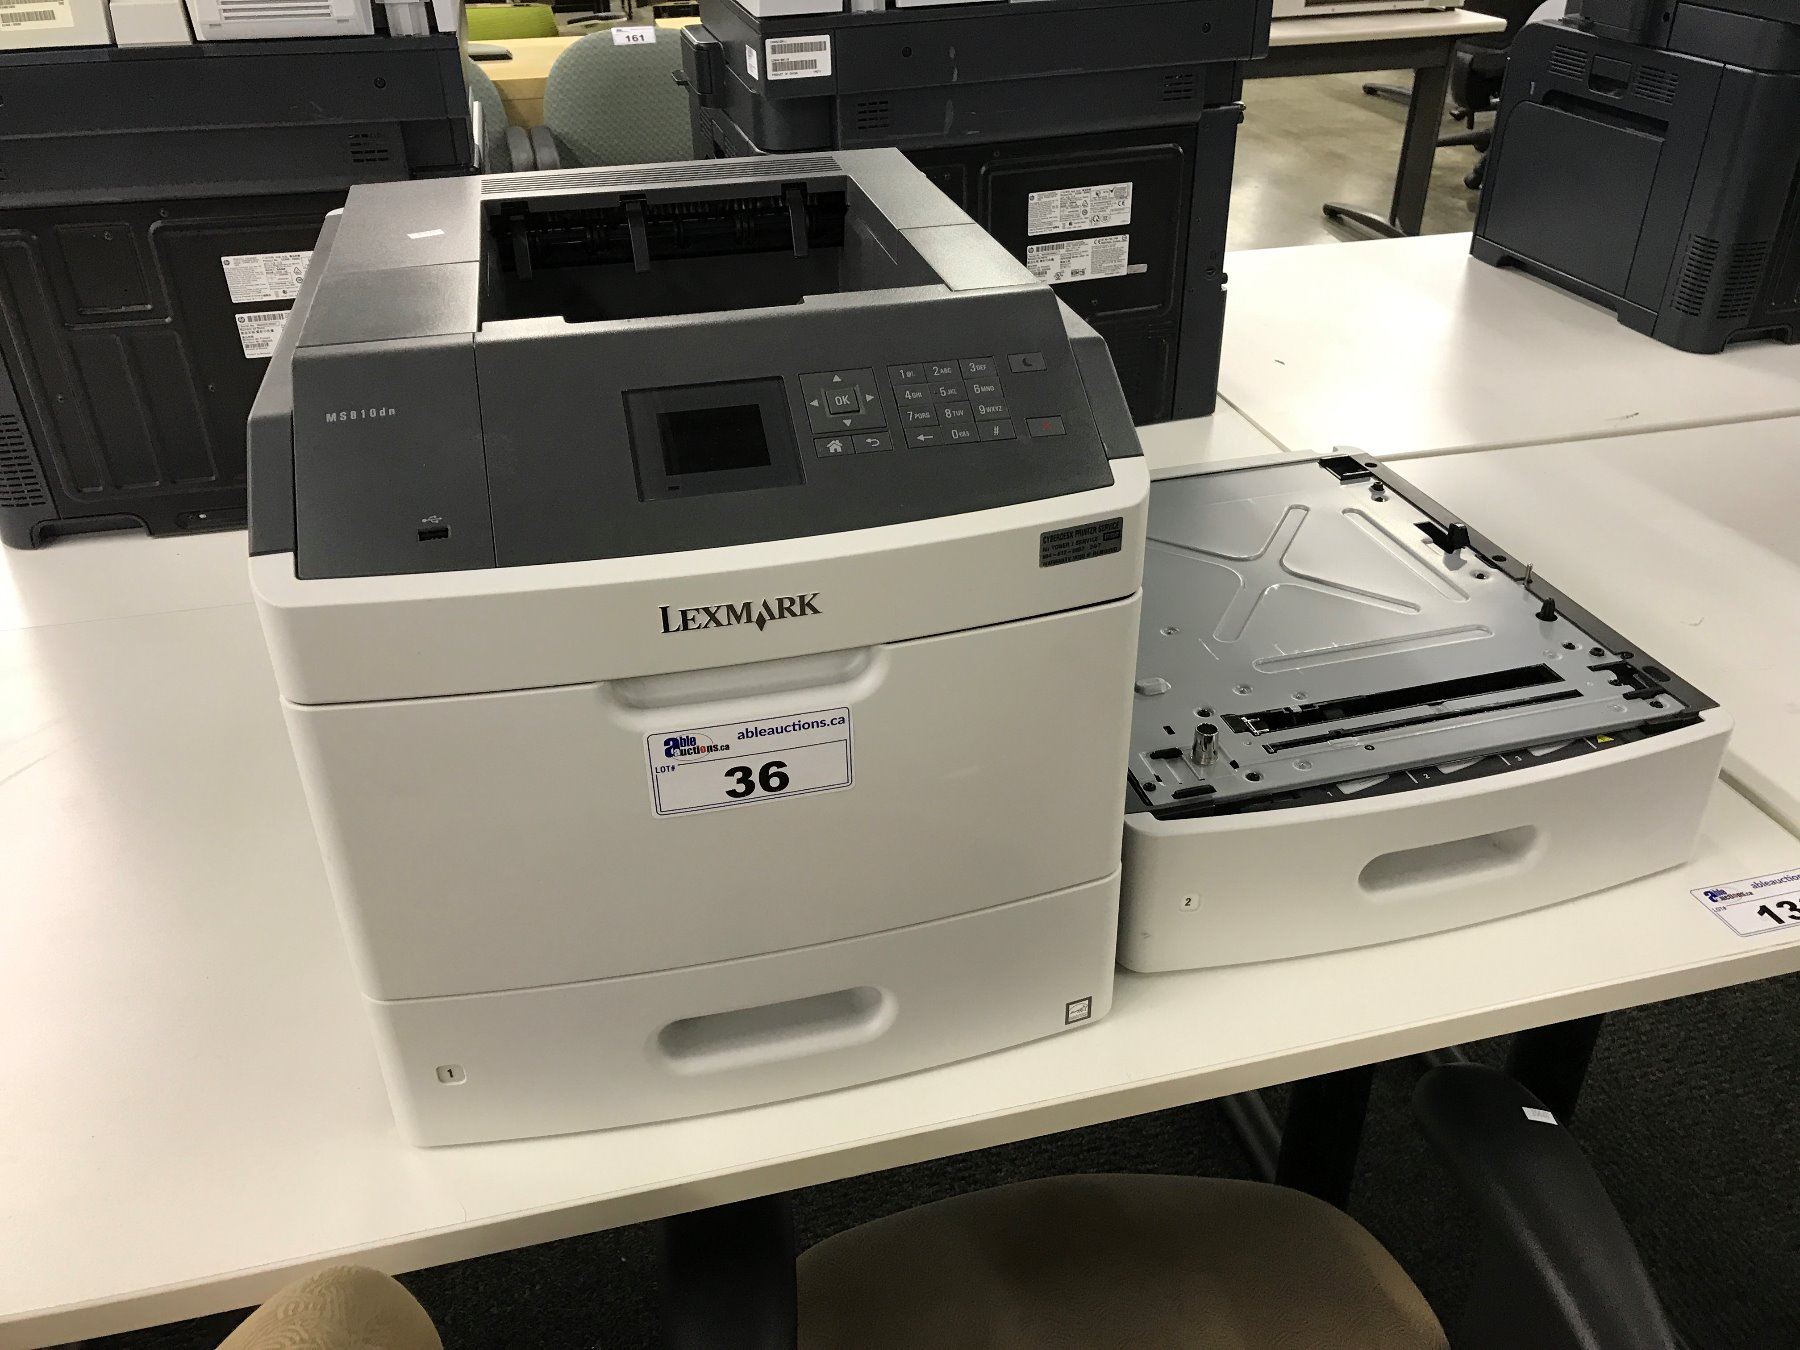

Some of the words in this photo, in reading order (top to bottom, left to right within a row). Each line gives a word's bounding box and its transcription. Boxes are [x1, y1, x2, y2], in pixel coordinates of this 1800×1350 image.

[625, 34, 645, 42] 161
[834, 394, 851, 406] OK
[325, 407, 396, 423] MS810dn
[658, 592, 823, 634] LEXMARK
[737, 715, 846, 741] ableauctions.ca
[654, 764, 676, 774] LOT#
[723, 760, 790, 799] 36
[1184, 897, 1192, 907] 2
[1757, 899, 1800, 925] 13
[446, 1068, 454, 1078] 1
